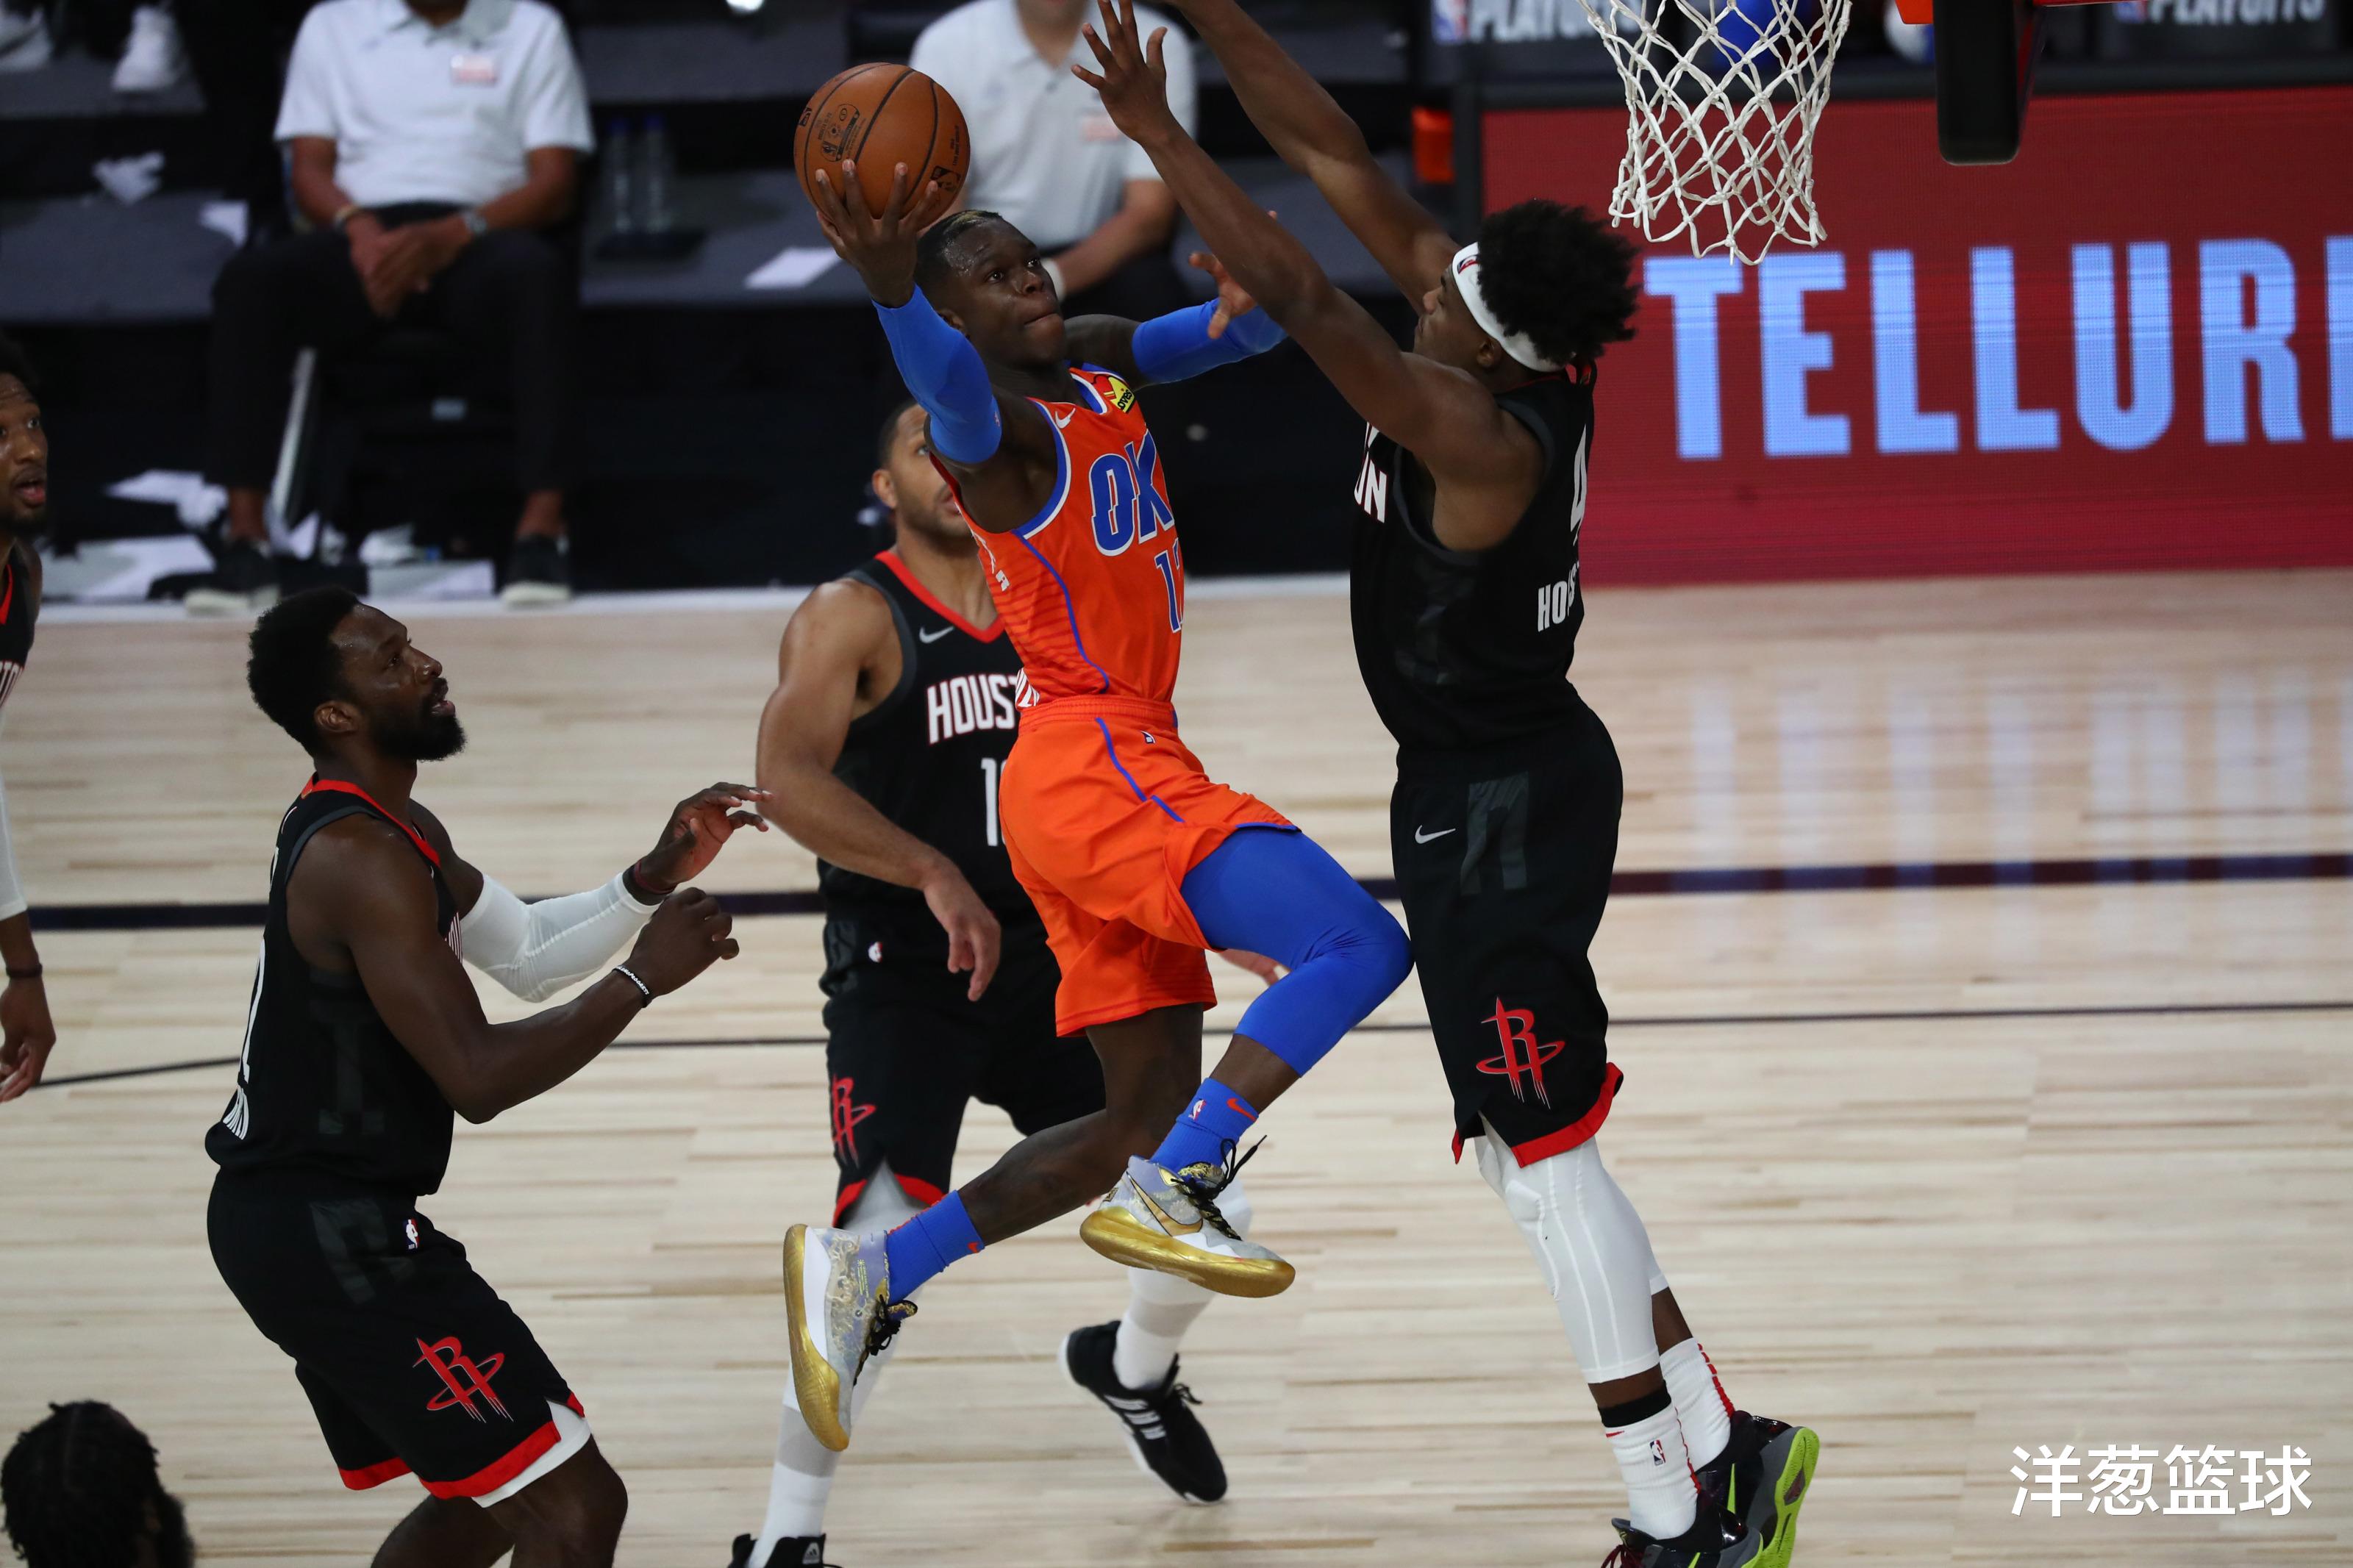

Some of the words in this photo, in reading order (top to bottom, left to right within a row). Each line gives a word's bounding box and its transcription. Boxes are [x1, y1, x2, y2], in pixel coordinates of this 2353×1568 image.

[1153, 537, 1183, 634] 1
[926, 672, 1021, 745] HOUS
[979, 756, 1007, 847] 1
